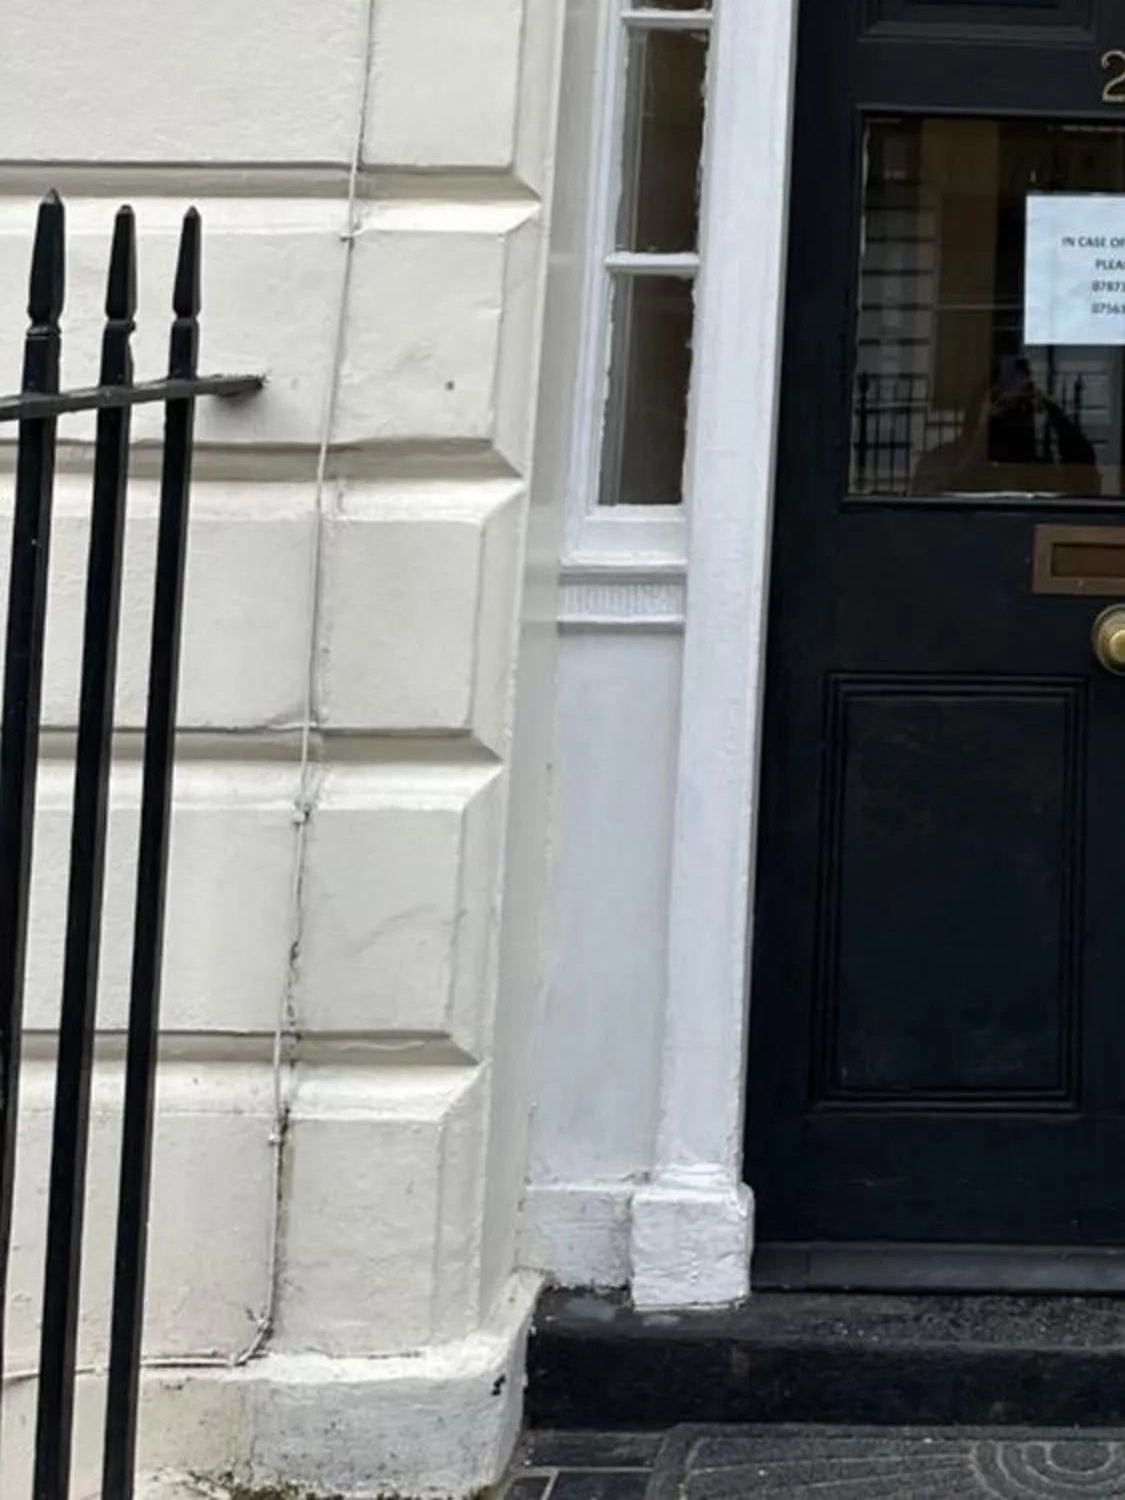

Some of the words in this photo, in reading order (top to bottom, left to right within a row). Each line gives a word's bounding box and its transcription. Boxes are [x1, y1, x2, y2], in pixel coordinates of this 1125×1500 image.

[1061, 236, 1075, 248] IN
[1078, 236, 1106, 249] CASE
[1110, 237, 1125, 249] OF
